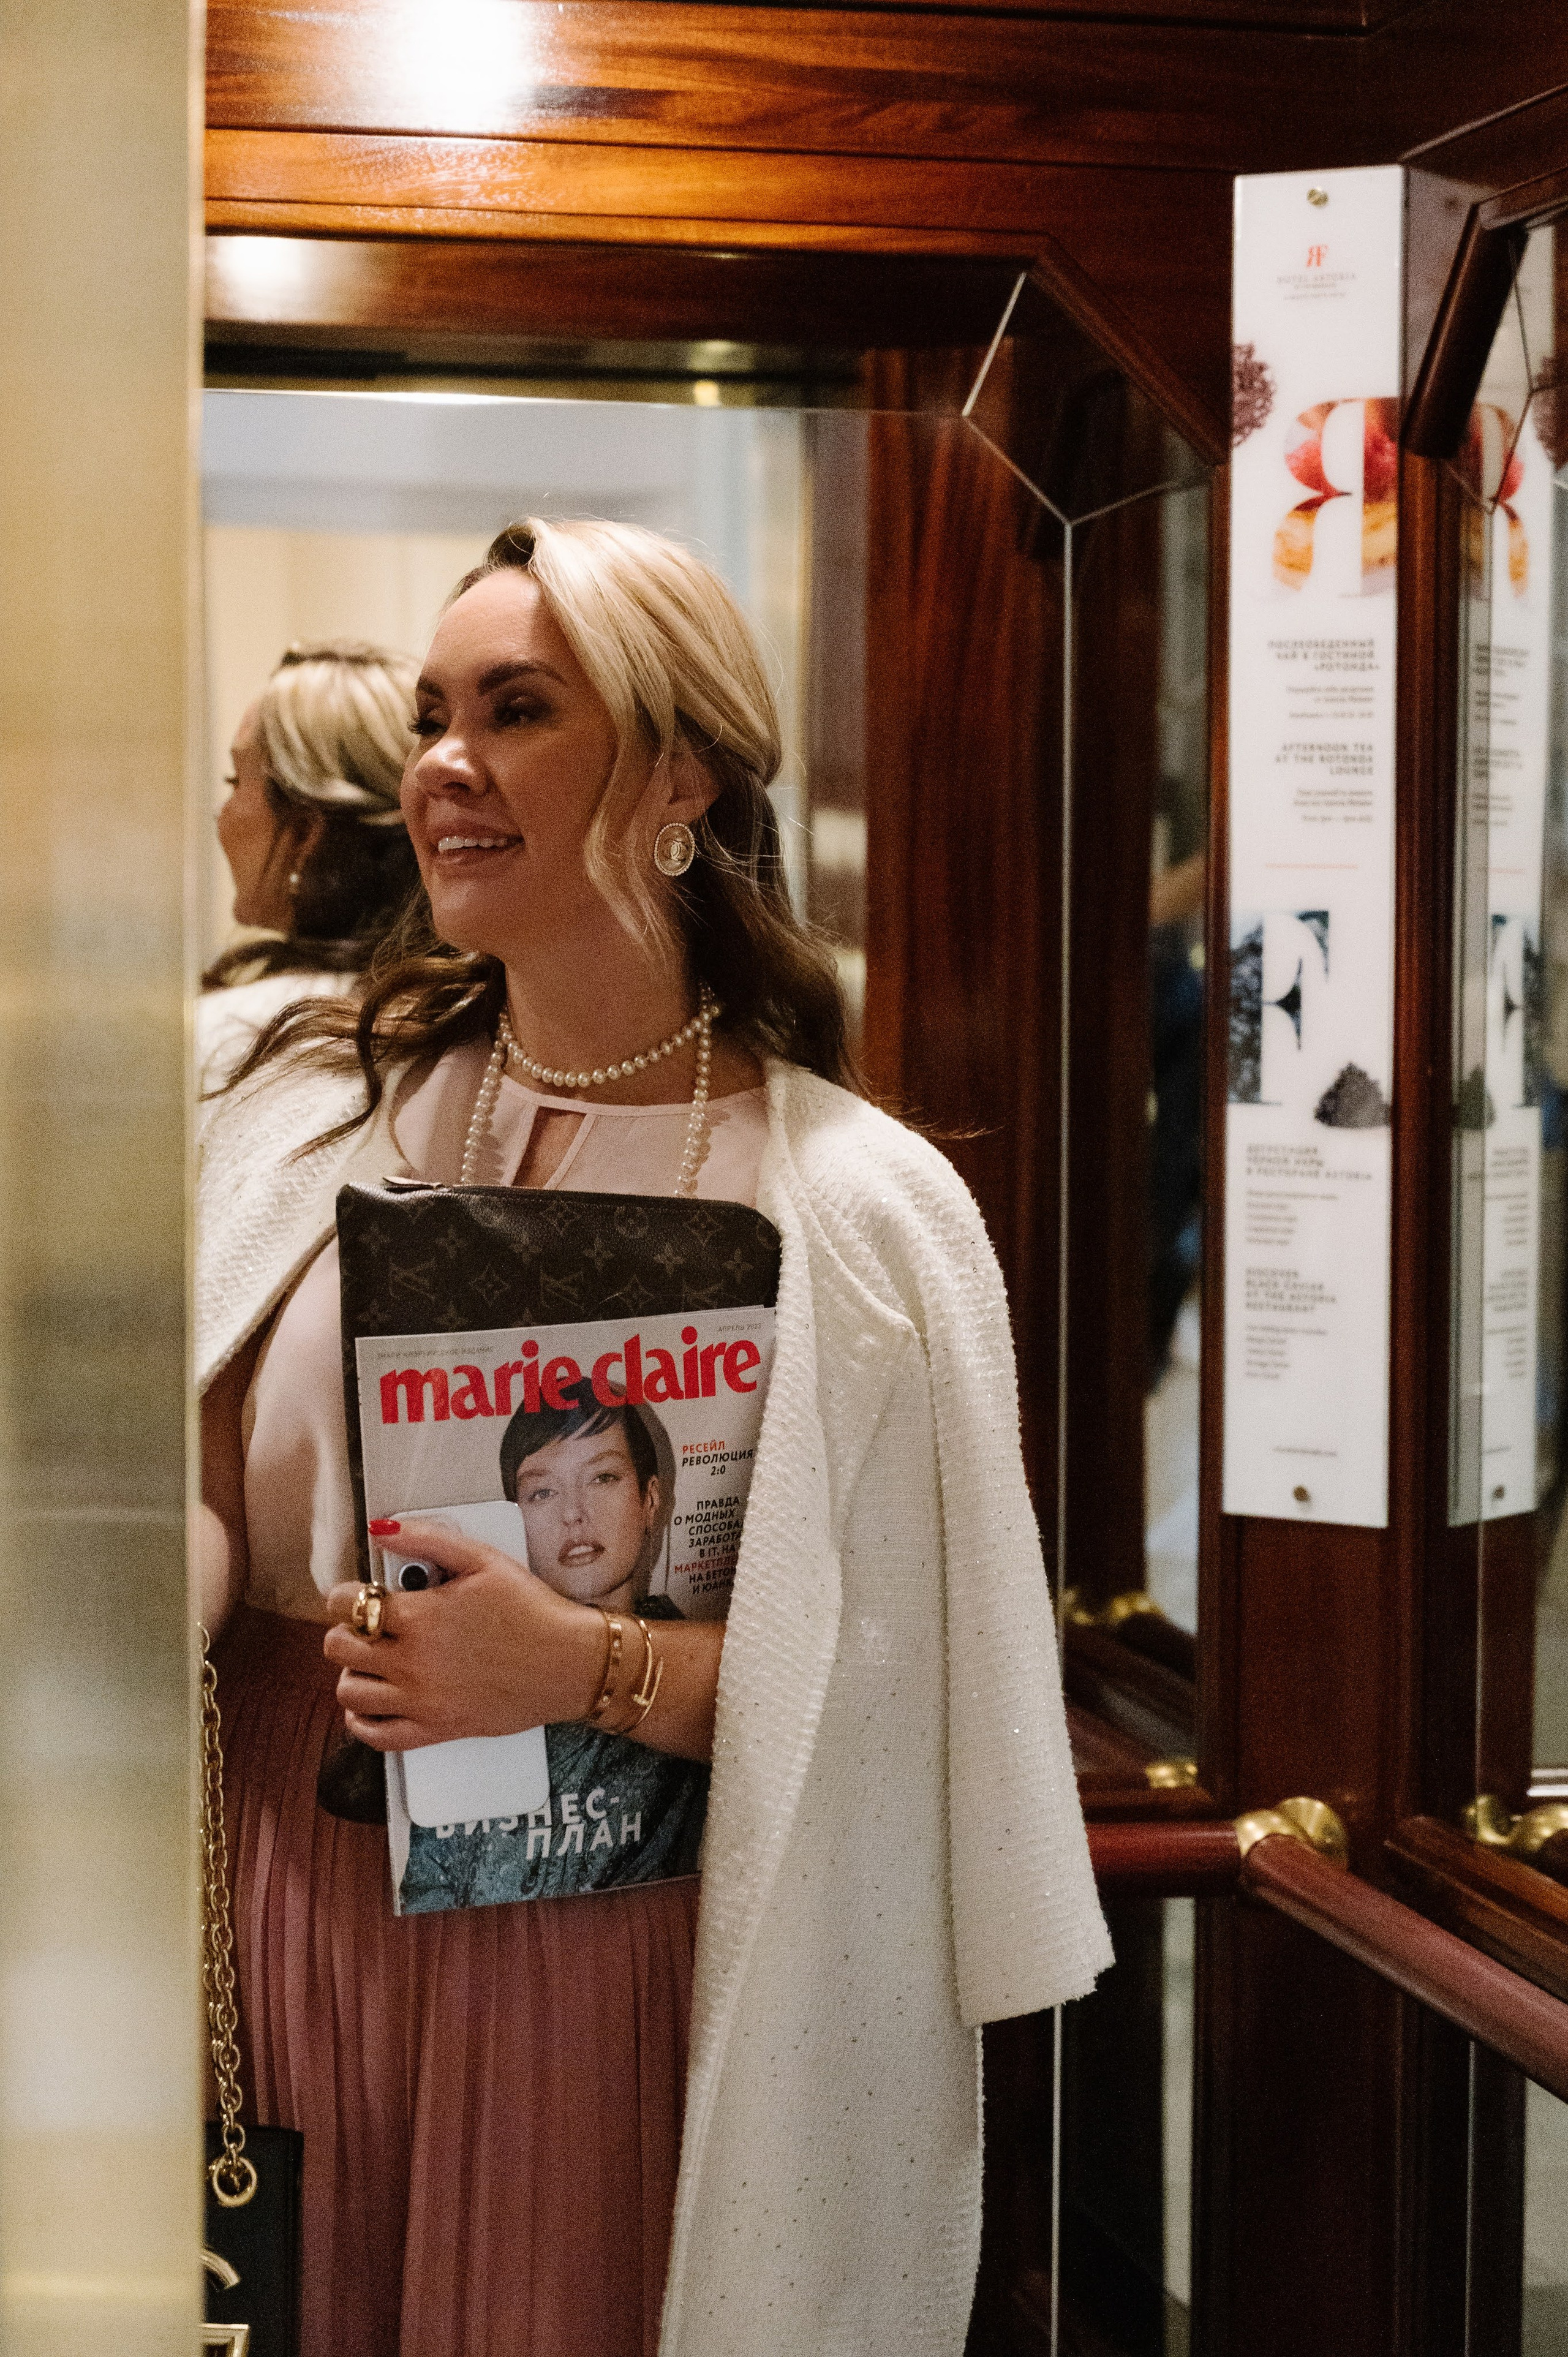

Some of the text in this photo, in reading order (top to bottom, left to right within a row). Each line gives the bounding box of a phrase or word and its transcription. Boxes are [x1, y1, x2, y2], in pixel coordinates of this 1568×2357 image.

[379, 1326, 761, 1424] marie claire
[682, 1439, 726, 1455] РЕСЕЙЛ
[682, 1449, 754, 1467] РЕВОЛЮЦИЯ
[710, 1465, 726, 1476] 2:0
[697, 1496, 740, 1510] ПРАВДА
[674, 1509, 735, 1525] О МОДНЫХ
[688, 1531, 741, 1548] ЗАРАБОТА
[699, 1548, 705, 1558] В
[722, 1544, 736, 1554] НА
[674, 1556, 737, 1574] МАРКЕТПЛЕ
[689, 1567, 736, 1584] НА БЕТОН
[693, 1579, 734, 1595] И ЮАНЯ
[526, 1811, 643, 1860] ПЛАН
